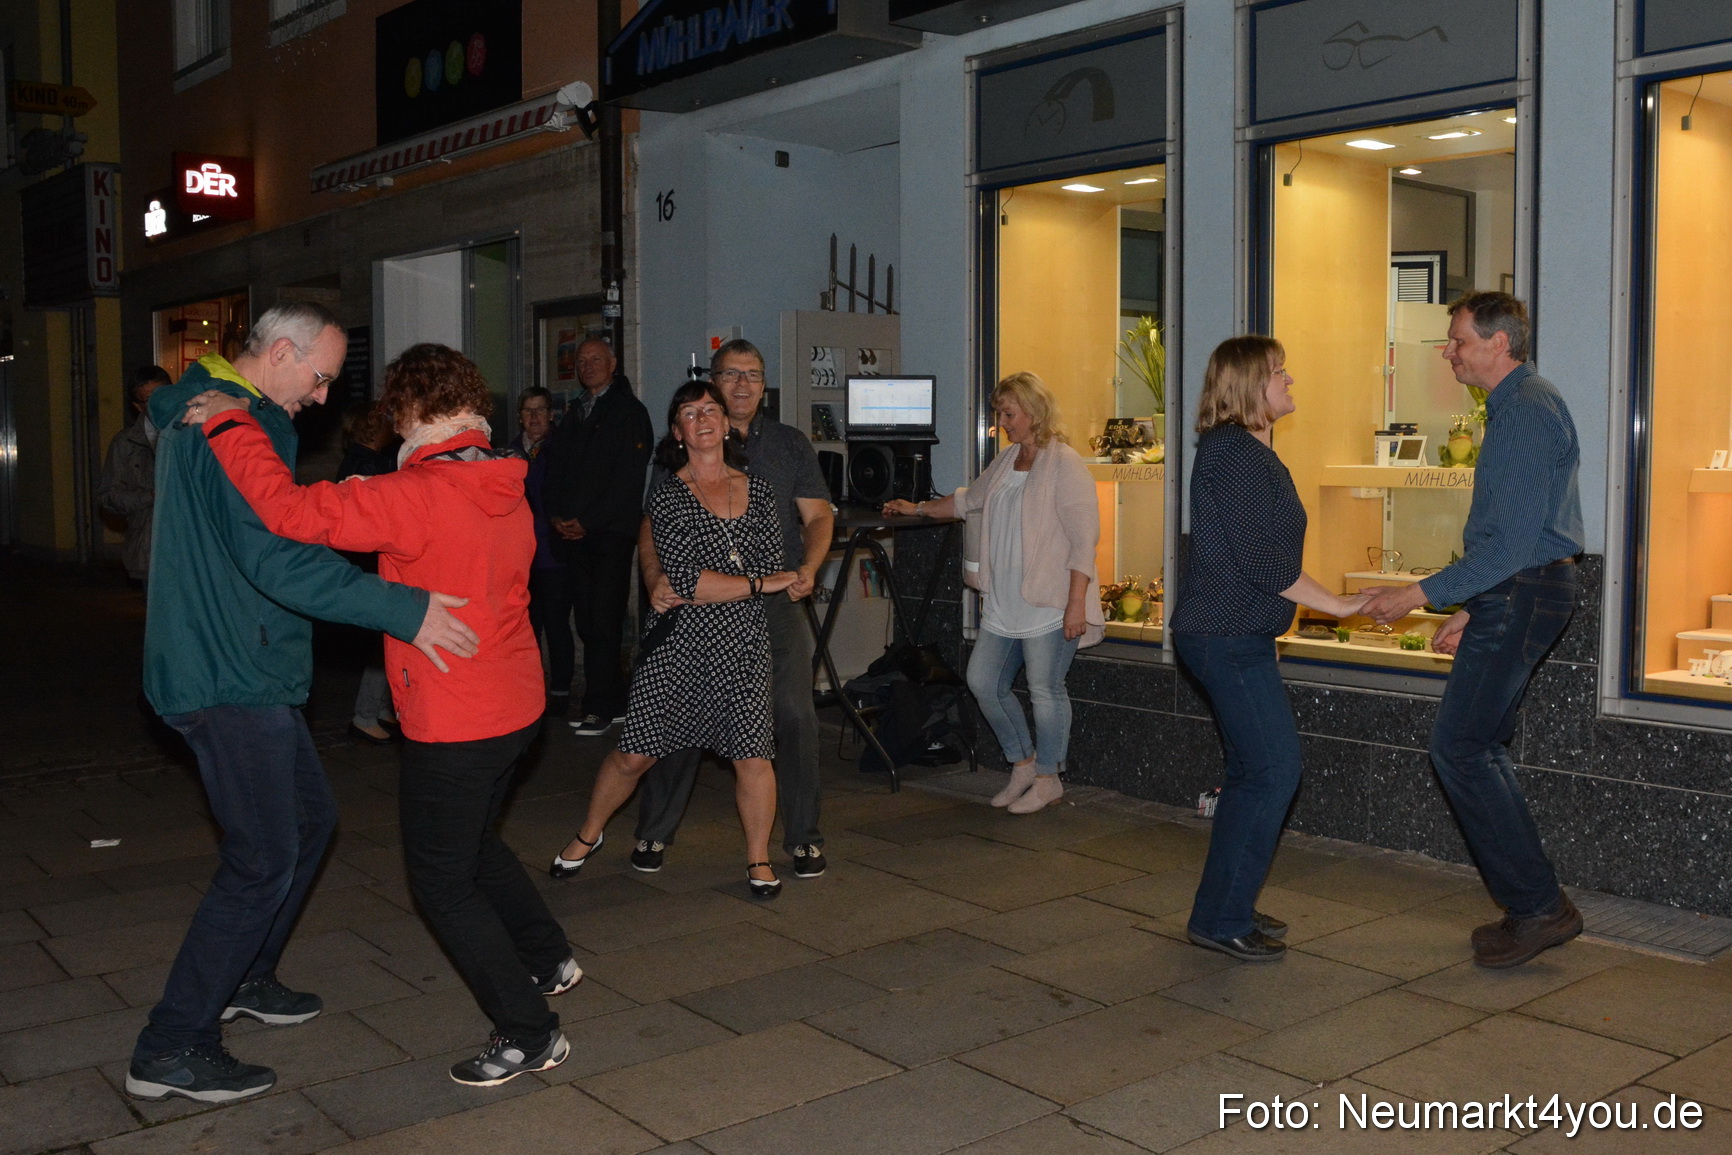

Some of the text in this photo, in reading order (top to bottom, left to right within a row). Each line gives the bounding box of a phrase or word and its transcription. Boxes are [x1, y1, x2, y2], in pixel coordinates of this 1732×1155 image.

[17, 84, 58, 107] KINO
[185, 165, 239, 198] DER
[655, 190, 675, 222] 16
[93, 170, 113, 283] KINO
